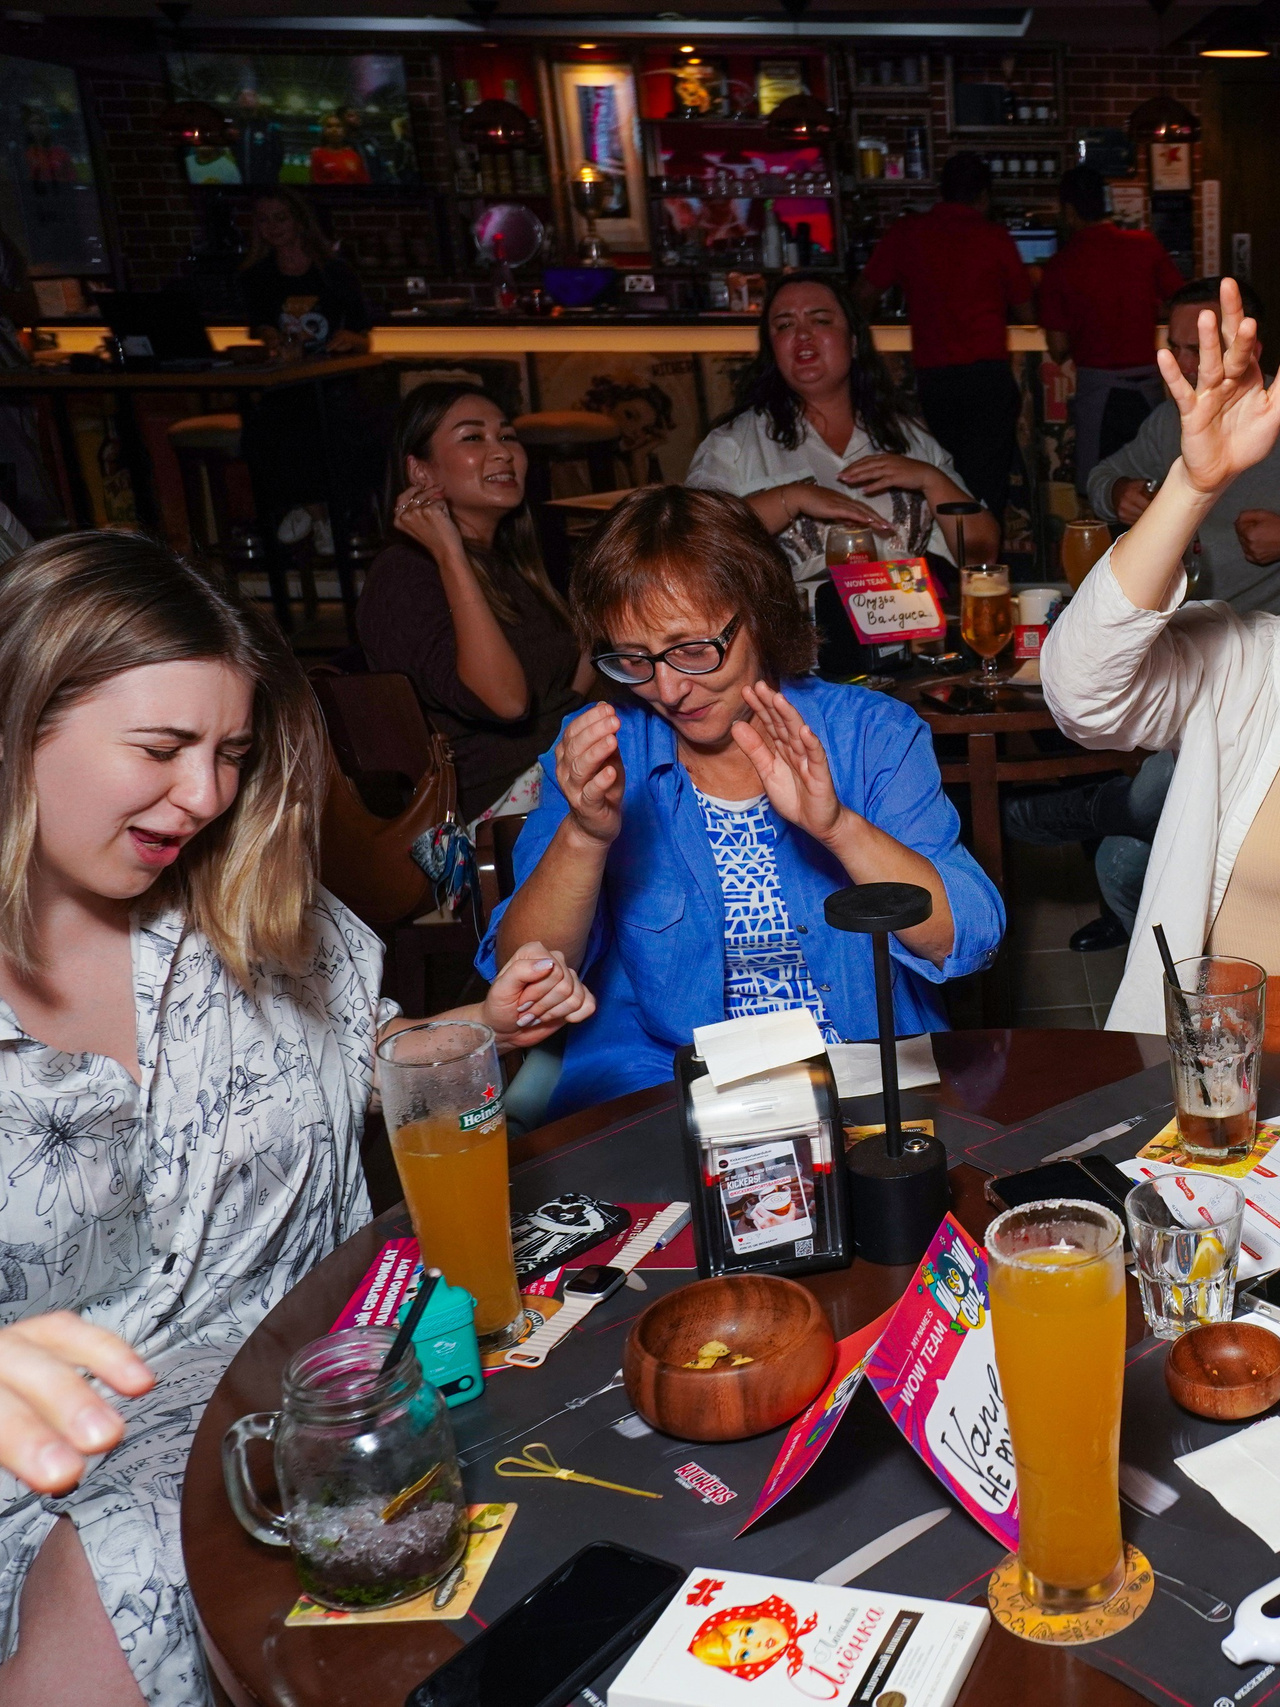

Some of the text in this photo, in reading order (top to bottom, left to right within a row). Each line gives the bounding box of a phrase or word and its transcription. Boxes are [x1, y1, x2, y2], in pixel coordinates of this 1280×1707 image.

[844, 577, 887, 588] WOW TEAM
[726, 1174, 761, 1190] KICKERS!
[361, 1245, 399, 1313] СЕРТИФИКАТ
[394, 1255, 412, 1280] ИГРУ
[912, 1334, 922, 1348] MY
[916, 1317, 931, 1340] NAME
[900, 1321, 948, 1407] WOW TEAM
[674, 1461, 738, 1505] KICKERS
[787, 1606, 884, 1700] Алёнка
